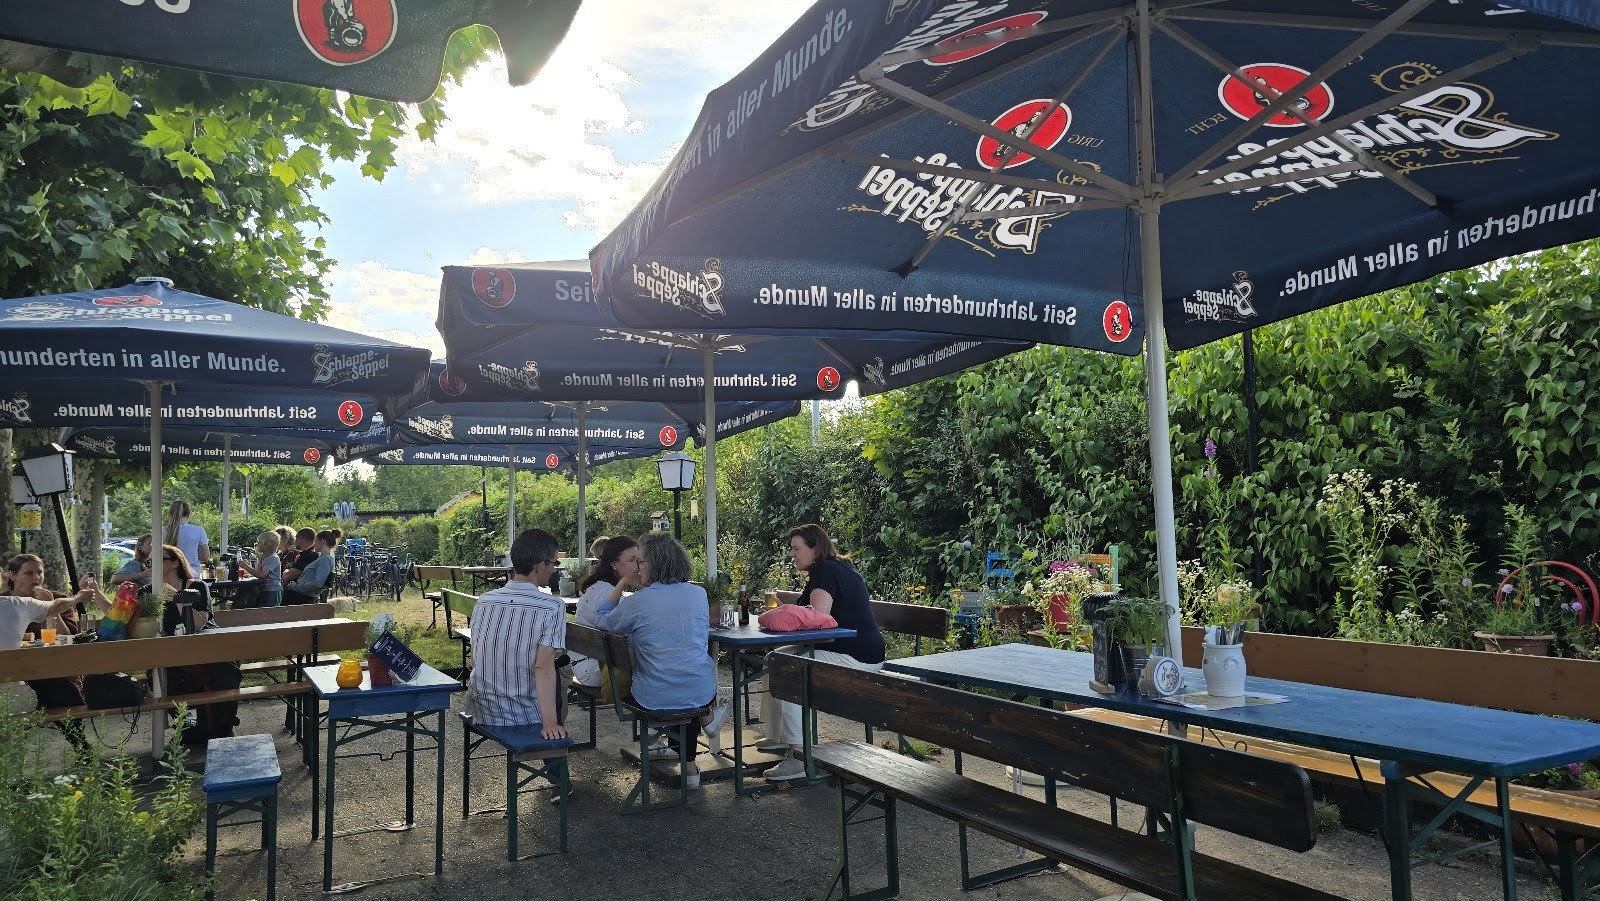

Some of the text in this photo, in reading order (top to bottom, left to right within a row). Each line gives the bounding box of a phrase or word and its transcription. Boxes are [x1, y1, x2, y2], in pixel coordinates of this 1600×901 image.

[725, 78, 768, 140] aller
[771, 7, 852, 98] Munde.
[121, 348, 144, 368] in
[150, 350, 202, 369] aller
[207, 351, 287, 374] Munde.
[351, 353, 390, 380] Seppel
